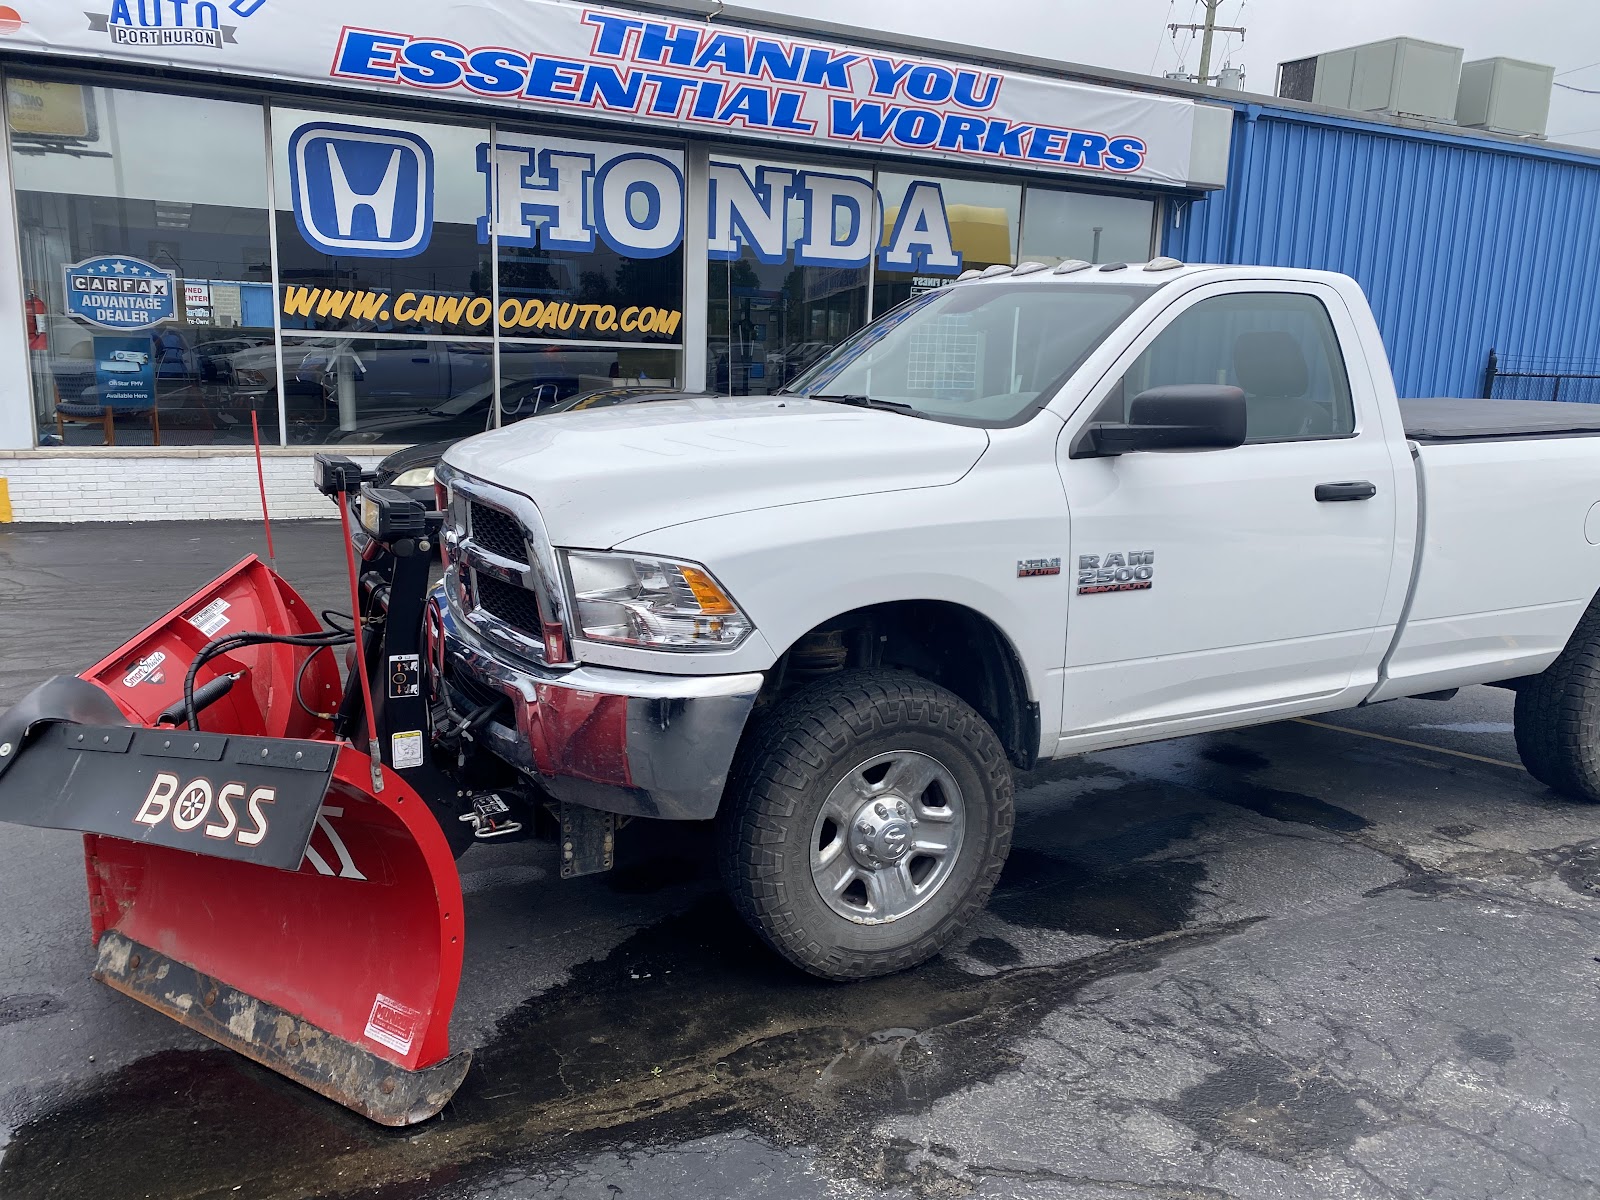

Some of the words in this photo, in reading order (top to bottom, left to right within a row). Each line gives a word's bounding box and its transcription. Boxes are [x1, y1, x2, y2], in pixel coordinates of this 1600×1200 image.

[117, 29, 158, 43] PORT
[163, 31, 215, 45] HURON
[583, 9, 866, 92] THANK
[869, 54, 1003, 111] YOU
[331, 26, 816, 134] ESSENTIAL
[829, 96, 1146, 171] WORKERS
[477, 143, 962, 273] HONDA
[75, 278, 164, 295] CARFAX
[82, 295, 162, 310] ADVANTAGE
[283, 286, 681, 335] WWW.CAWOODAUTO.COM
[96, 309, 149, 323] DEALER
[1017, 557, 1061, 570] HEMI
[1079, 550, 1155, 570] RAM
[1035, 567, 1060, 576] LITER
[1078, 565, 1154, 586] 2500
[1080, 584, 1118, 594] HEAVY
[1119, 581, 1150, 591] DUTY
[133, 771, 276, 847] BOSS
